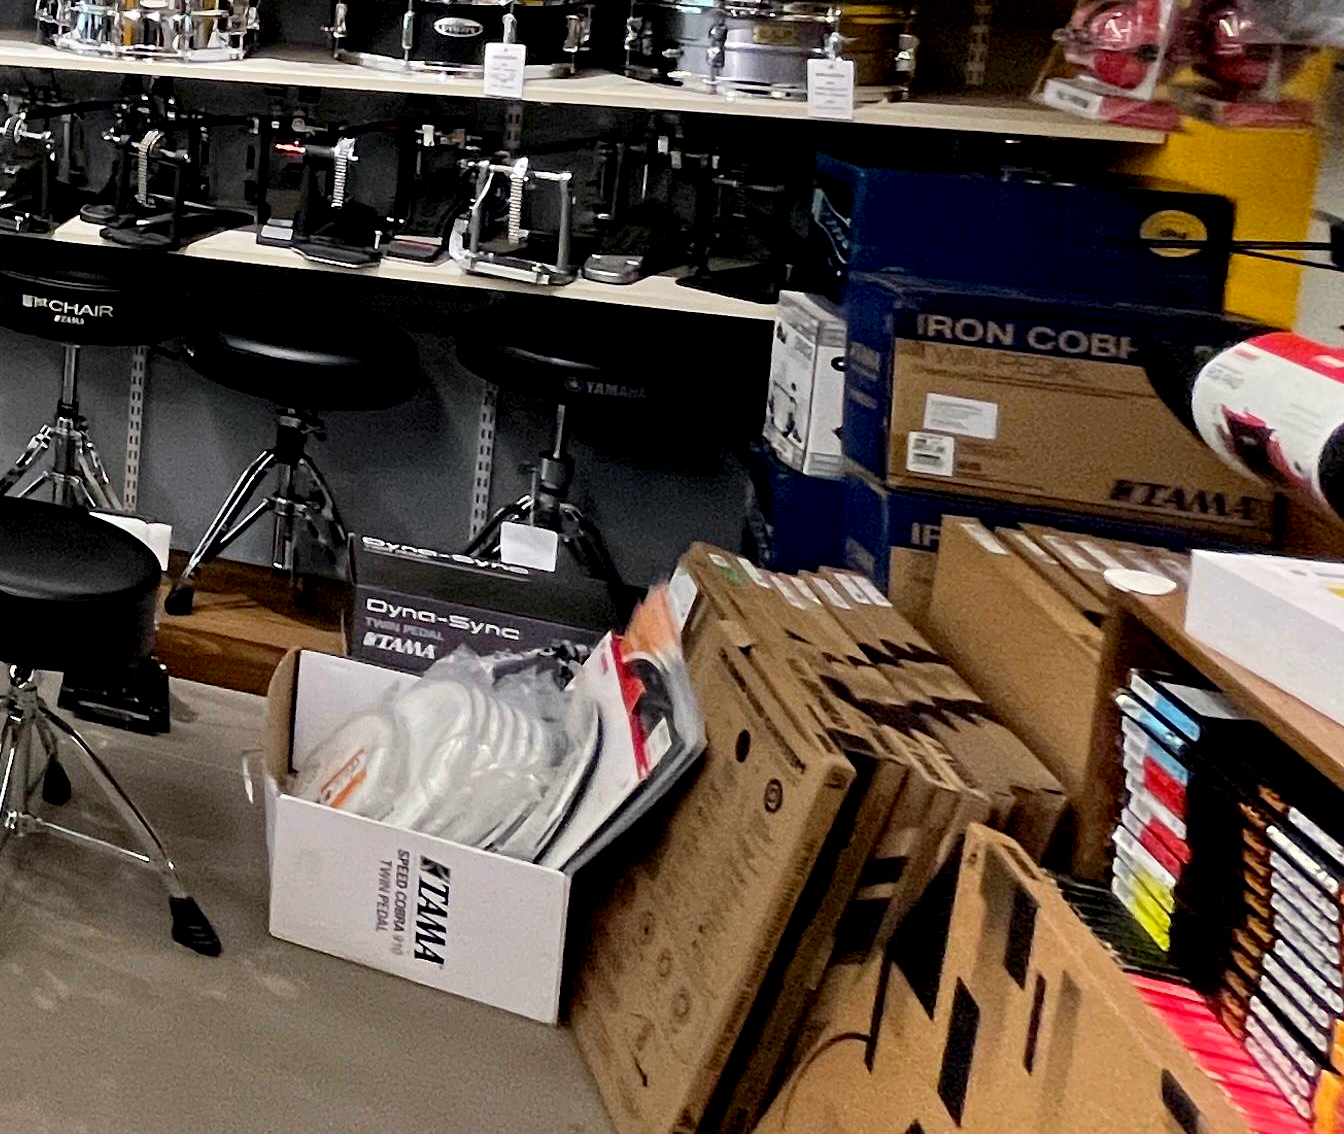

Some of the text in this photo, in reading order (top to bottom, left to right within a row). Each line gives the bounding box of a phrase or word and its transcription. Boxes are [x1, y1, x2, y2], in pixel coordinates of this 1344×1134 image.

[49, 300, 114, 317] CHAIR
[917, 314, 1015, 345] IRON
[366, 598, 520, 641] Dyna-Sync
[403, 623, 445, 642] PEDAL
[378, 633, 437, 660] TAMA
[396, 849, 410, 889] SPEED
[376, 859, 393, 932] TWIN PEDAL
[393, 891, 408, 932] COBRA
[414, 875, 450, 965] TAMA
